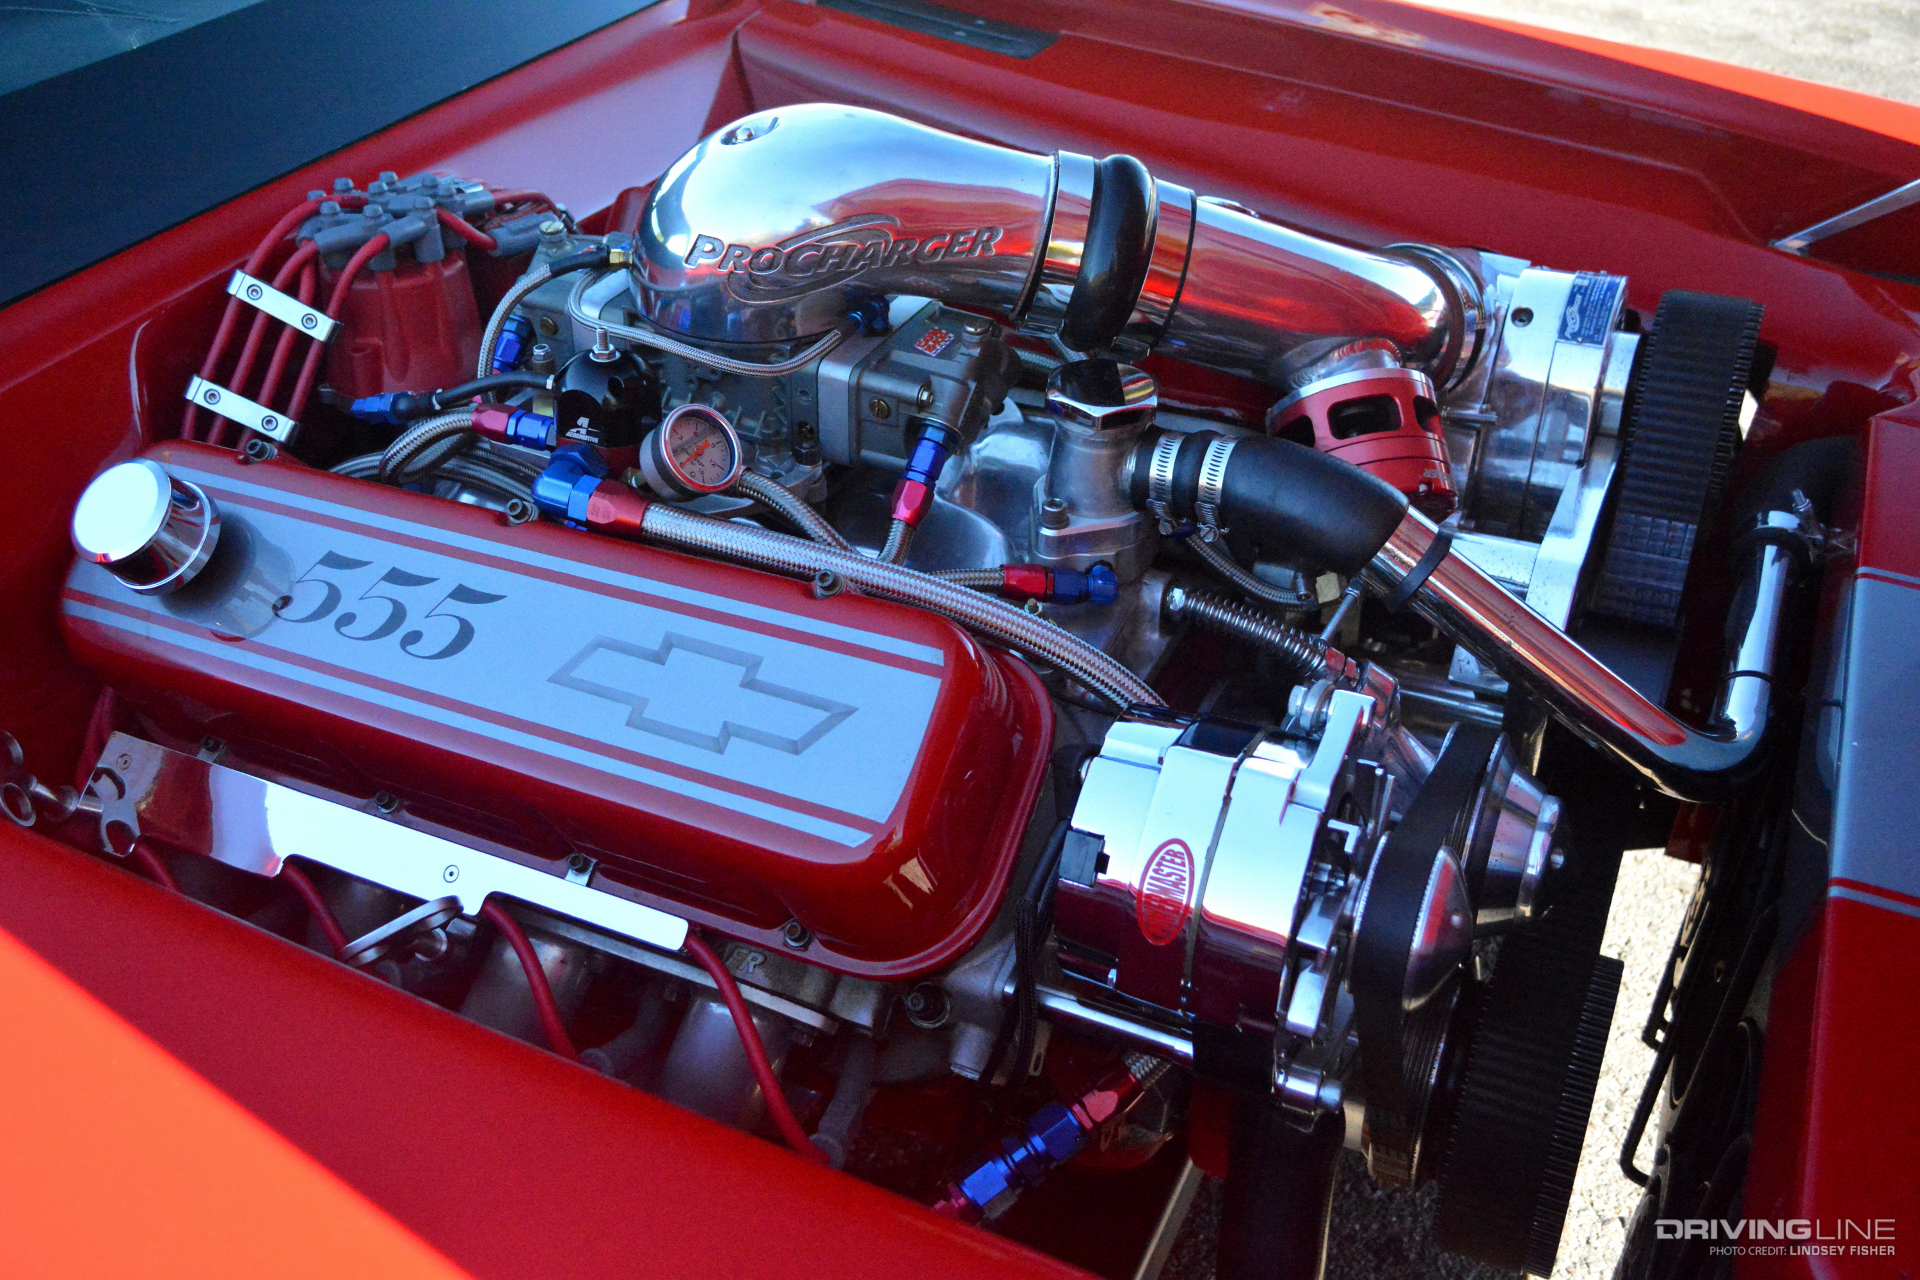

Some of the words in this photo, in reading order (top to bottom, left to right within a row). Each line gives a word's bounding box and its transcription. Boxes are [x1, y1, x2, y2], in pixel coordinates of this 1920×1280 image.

[683, 225, 1004, 276] PROCHARGER
[271, 550, 508, 661] 555
[1143, 848, 1187, 938] ERMASTER
